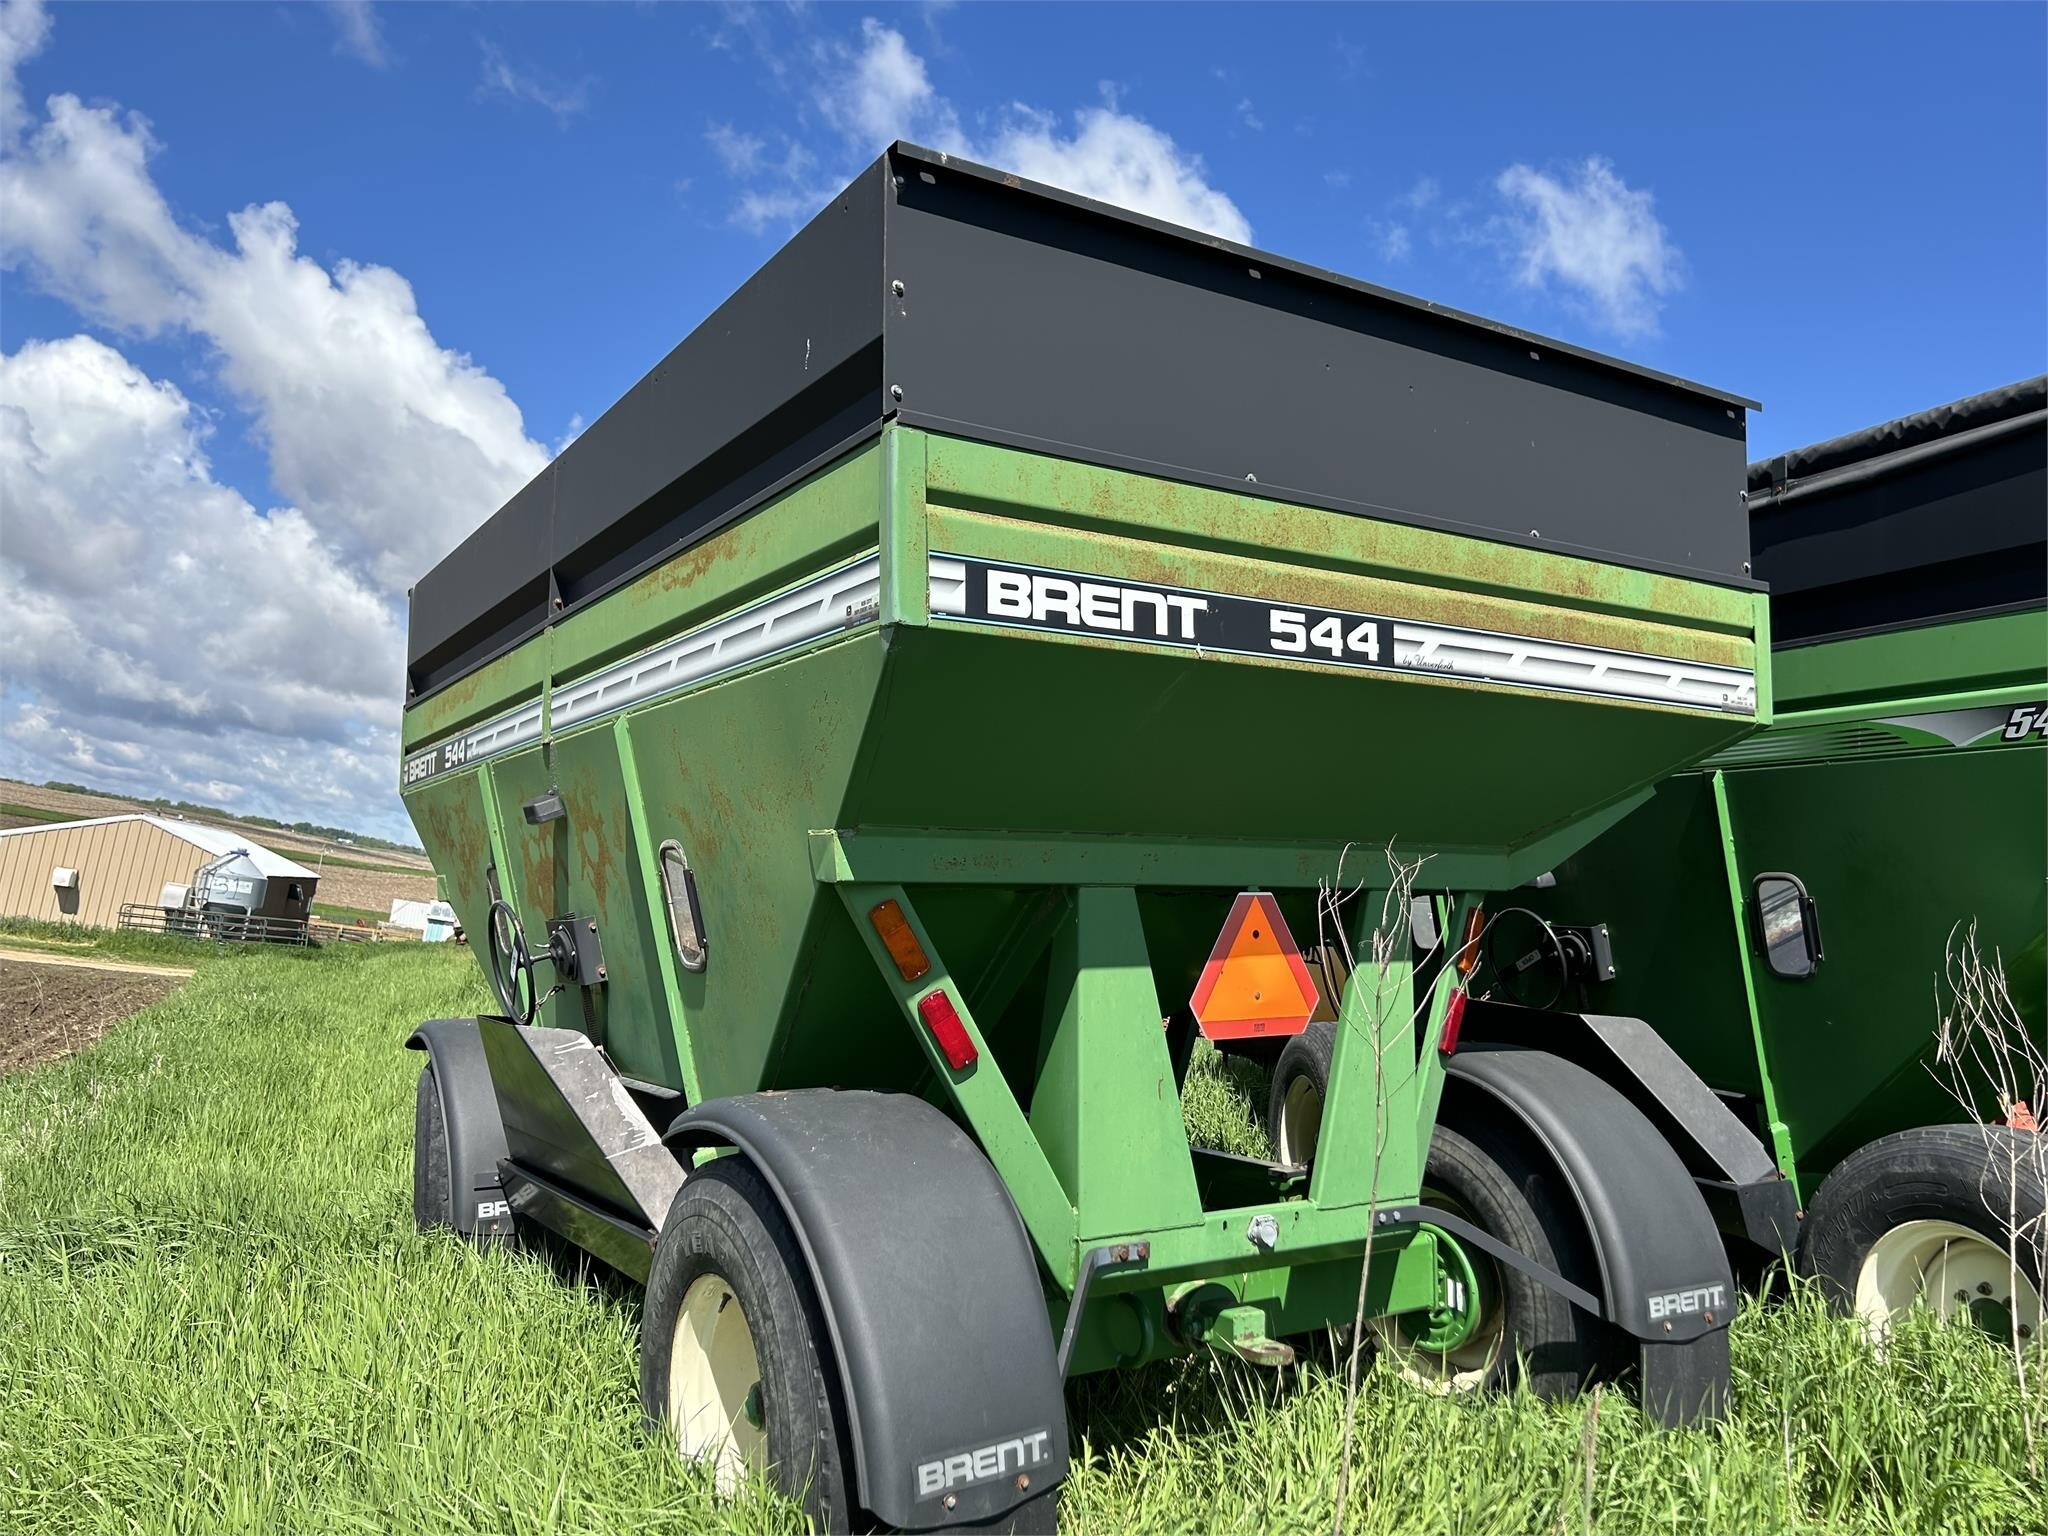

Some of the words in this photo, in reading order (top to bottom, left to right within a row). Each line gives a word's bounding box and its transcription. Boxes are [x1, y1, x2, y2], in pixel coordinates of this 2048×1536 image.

[987, 569, 1208, 640] BRENT
[1269, 609, 1380, 662] 544
[1402, 655, 1412, 667] by
[409, 751, 437, 782] BRENT
[444, 739, 465, 769] 544
